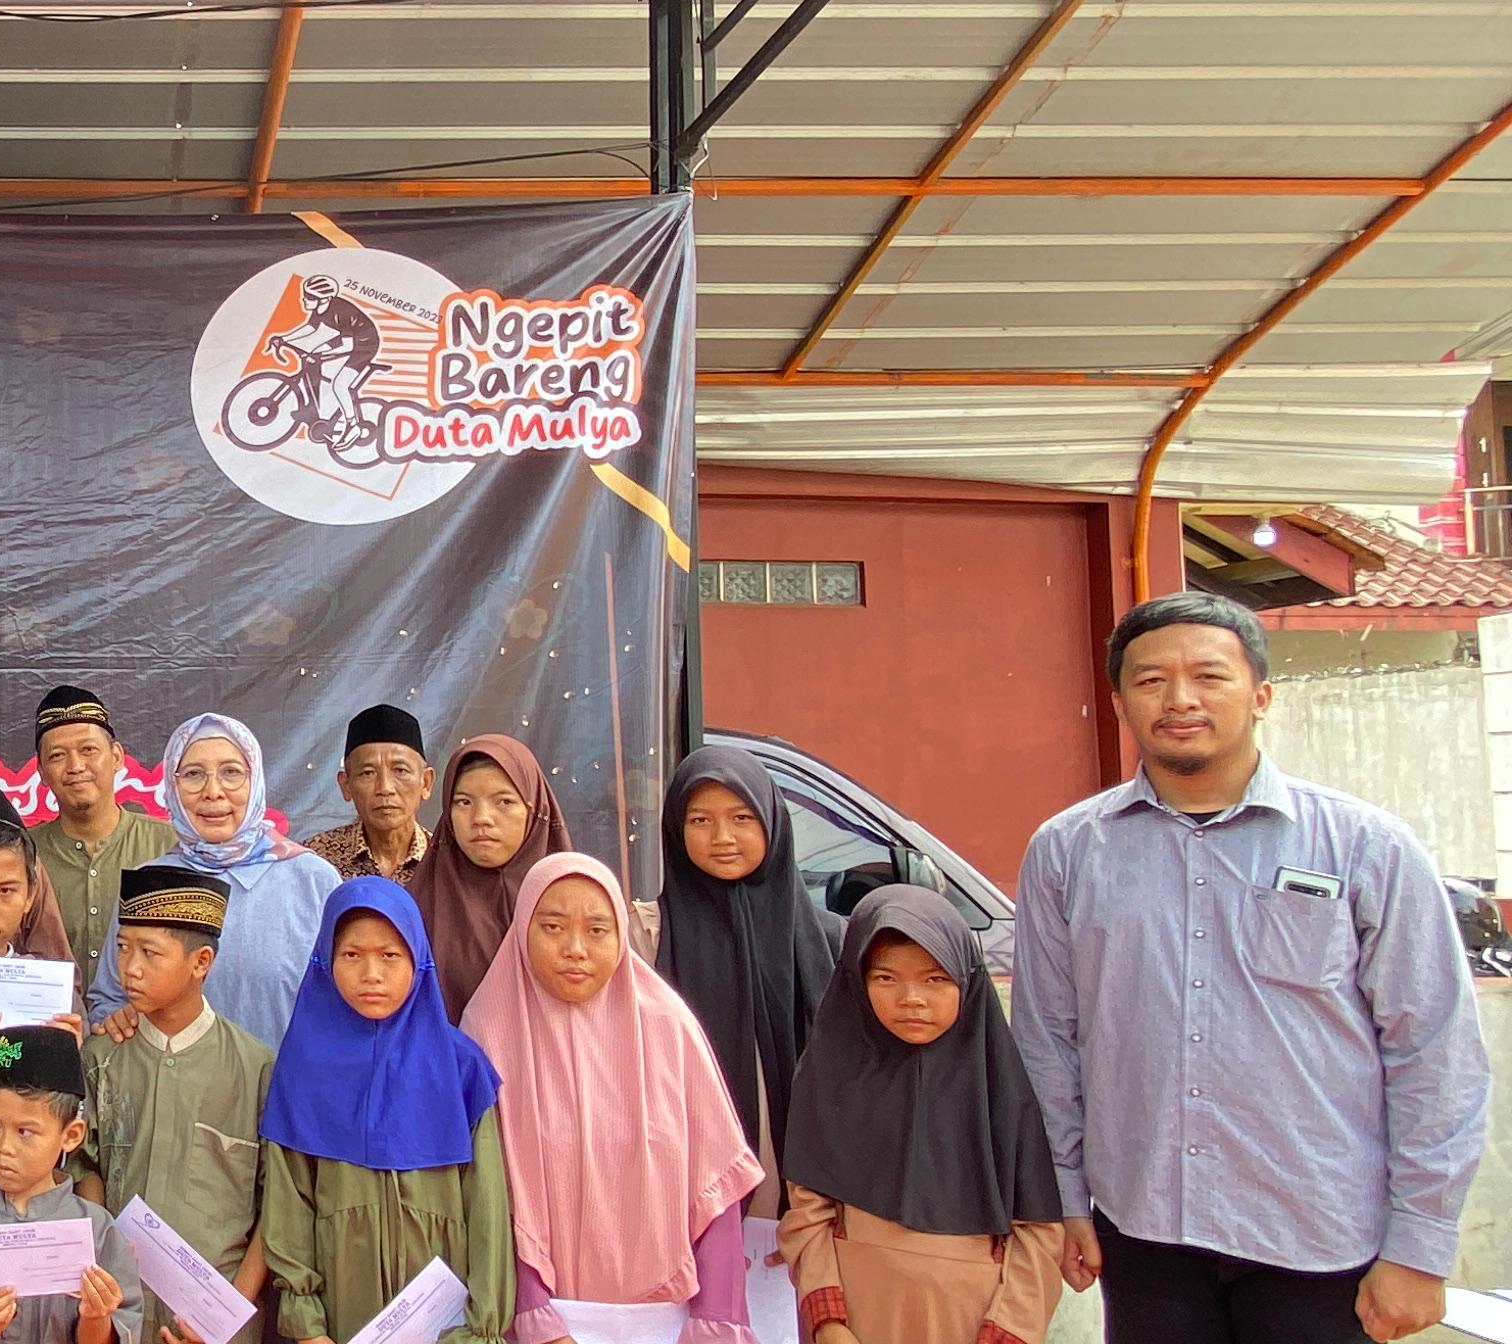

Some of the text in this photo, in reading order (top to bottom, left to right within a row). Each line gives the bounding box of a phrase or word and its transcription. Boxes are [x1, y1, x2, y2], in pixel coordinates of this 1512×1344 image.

[343, 278, 359, 291] 25
[359, 285, 417, 313] NOVEMBER
[451, 289, 634, 356] Ngepit
[440, 352, 632, 403] Bareng
[393, 404, 633, 454] Duta Mulya
